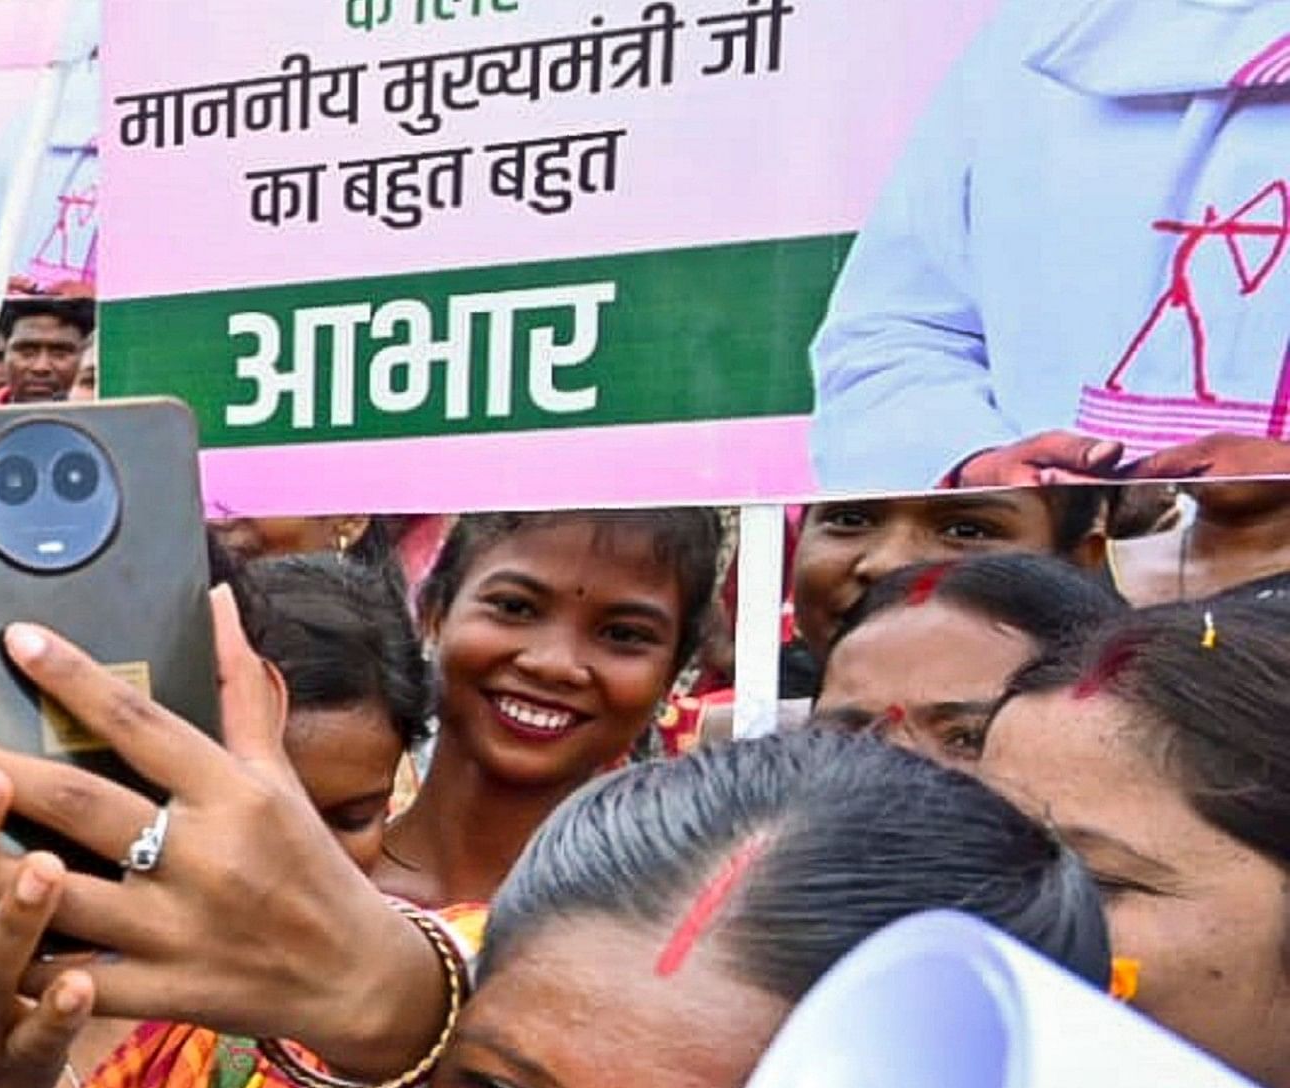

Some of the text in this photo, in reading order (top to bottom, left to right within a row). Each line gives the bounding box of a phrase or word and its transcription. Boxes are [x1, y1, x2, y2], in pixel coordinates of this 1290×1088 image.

[115, 0, 794, 148] माननीय मुख्यमंत्री जी
[245, 128, 627, 229] का बहुत बहुत
[224, 281, 617, 430] आभार
